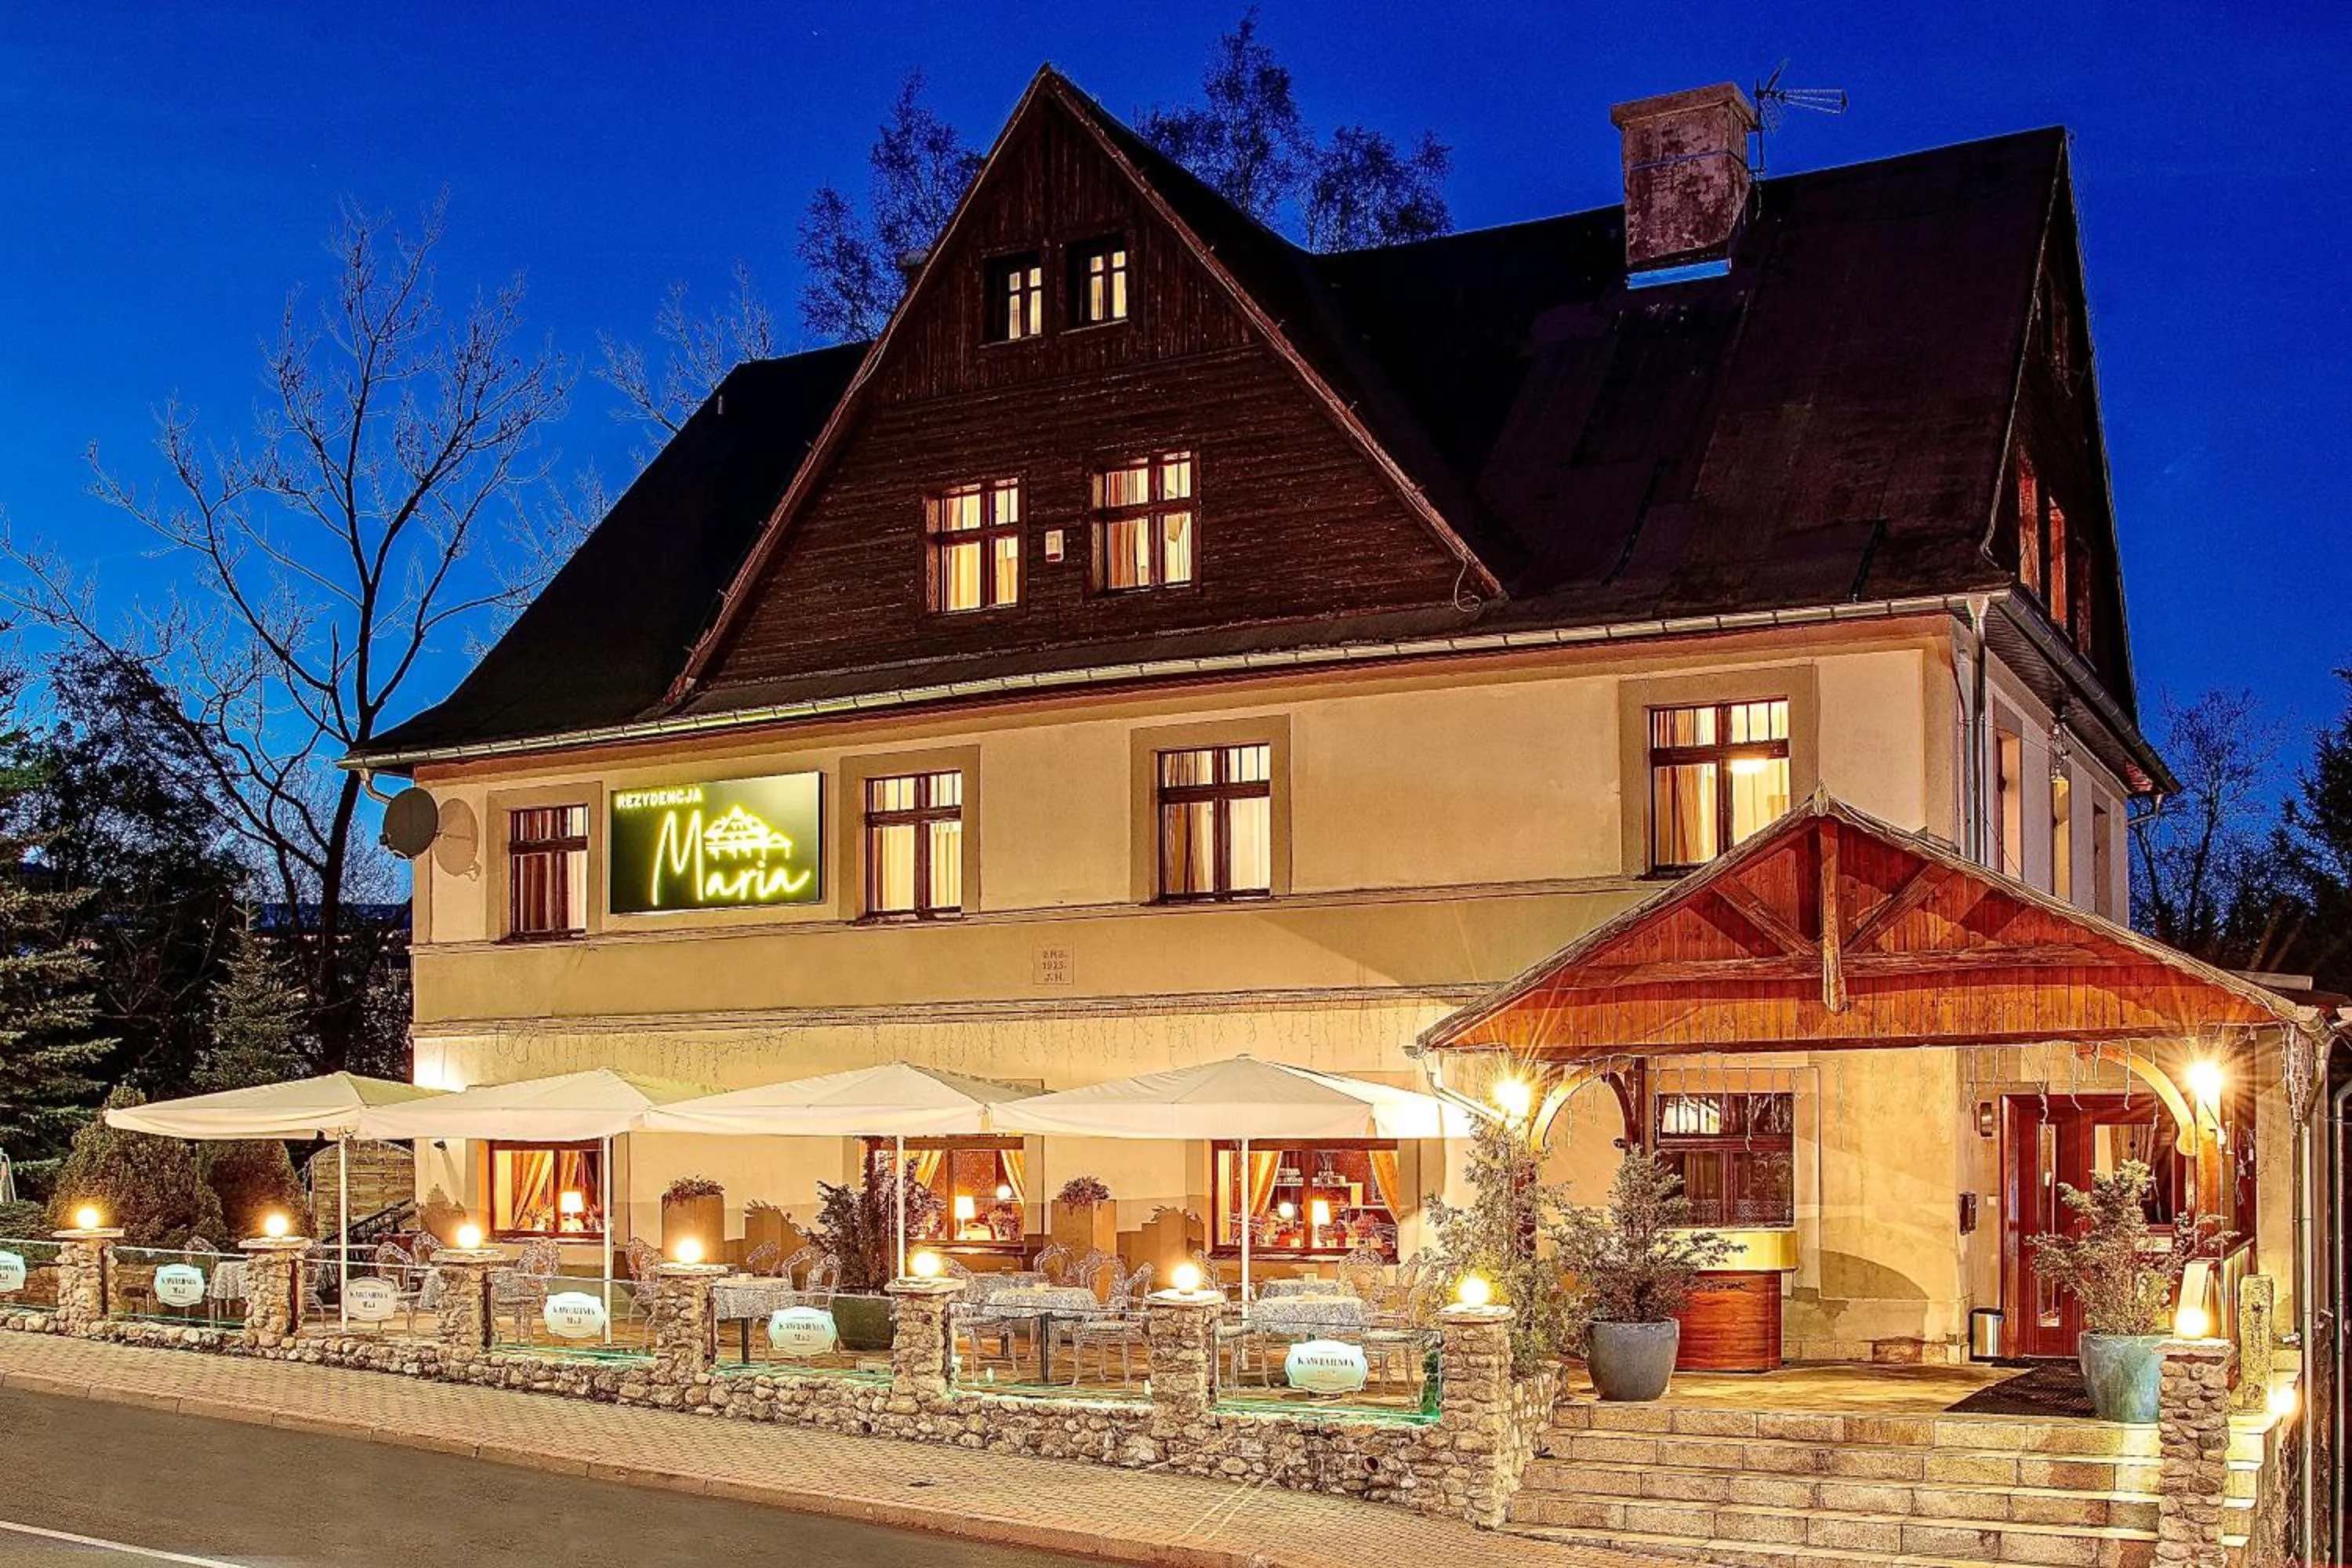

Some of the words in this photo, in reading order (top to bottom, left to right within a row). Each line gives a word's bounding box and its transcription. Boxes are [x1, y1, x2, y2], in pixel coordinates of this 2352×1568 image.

[615, 786, 703, 809] REZYDENCJA
[651, 808, 811, 907] Maria
[1297, 1357, 1355, 1367] KAWIARNIA
